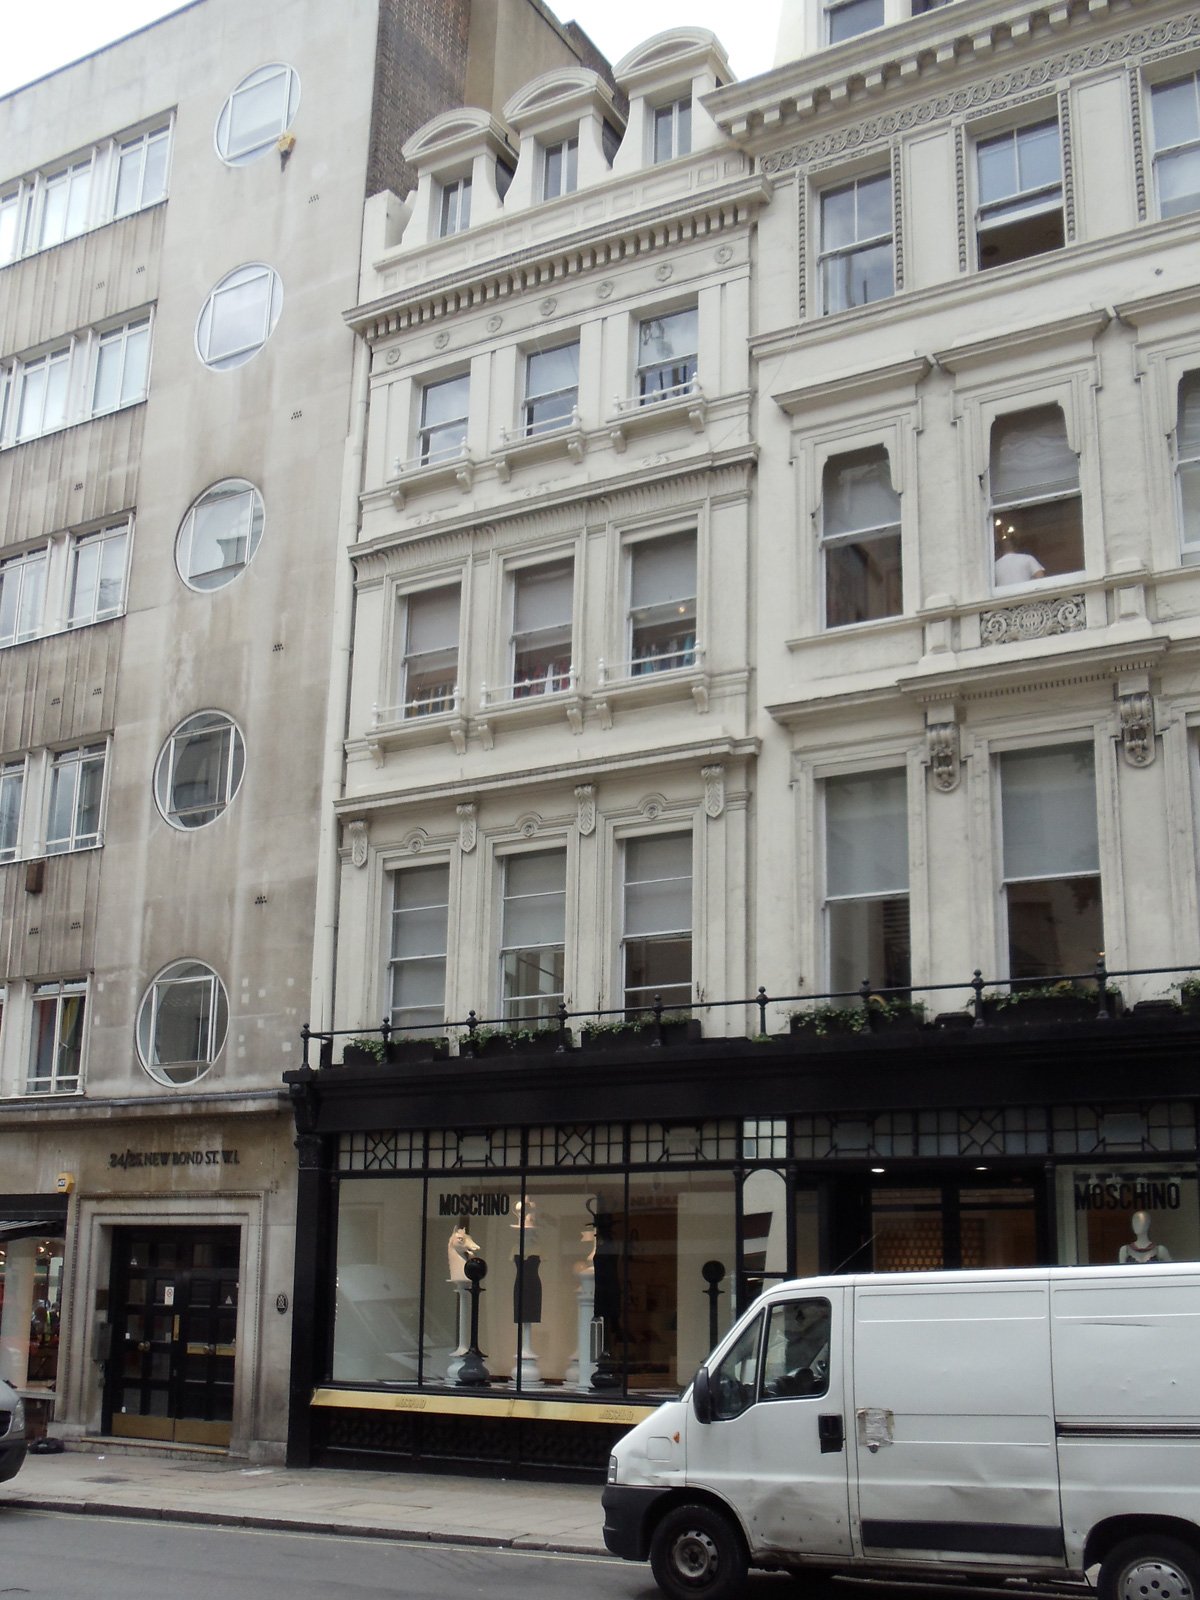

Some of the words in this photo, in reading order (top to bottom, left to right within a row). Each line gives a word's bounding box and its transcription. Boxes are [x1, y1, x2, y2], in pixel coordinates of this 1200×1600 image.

[144, 1152, 171, 1167] NEW
[172, 1151, 203, 1166] BOND
[439, 1193, 510, 1216] MOSCHINO
[1074, 1183, 1180, 1210] MOSCHINO
